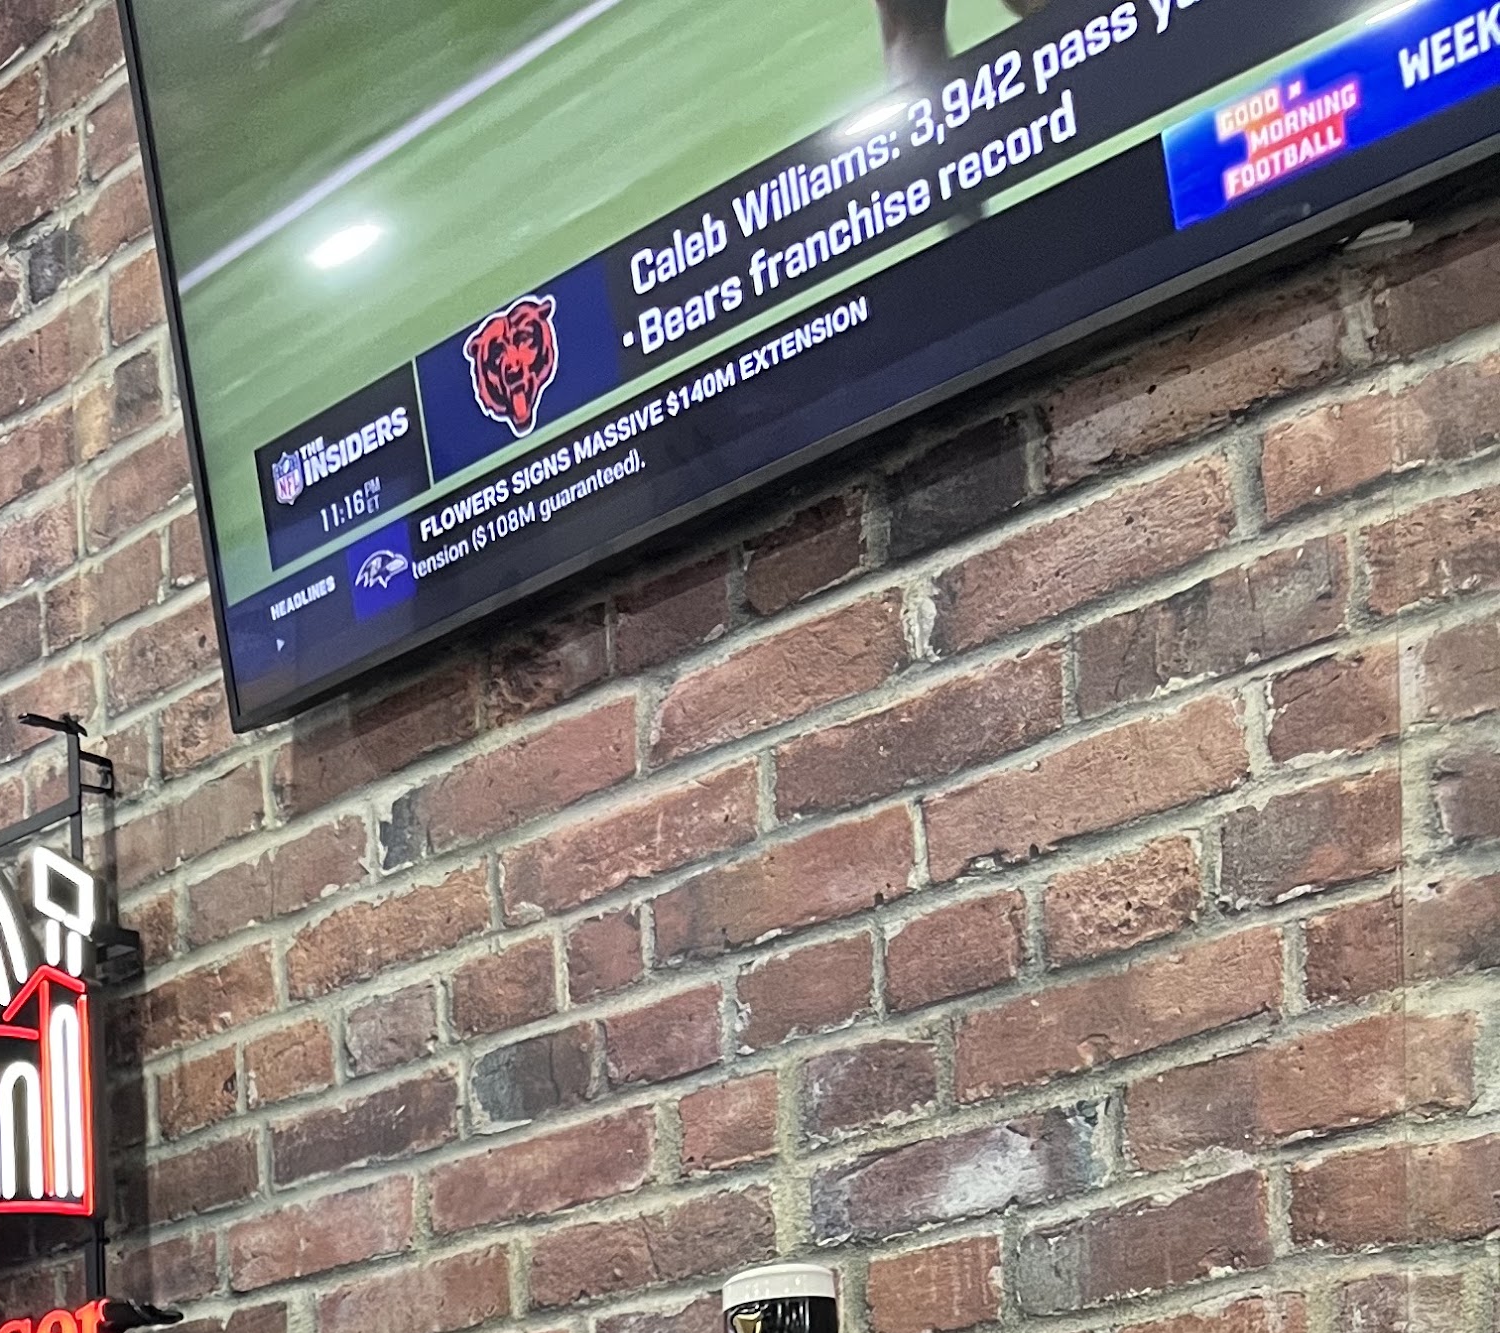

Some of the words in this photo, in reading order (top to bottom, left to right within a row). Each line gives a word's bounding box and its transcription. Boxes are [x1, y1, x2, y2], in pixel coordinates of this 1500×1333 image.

[1398, 2, 1500, 88] WEEK
[1219, 91, 1279, 130] GOOD
[1250, 84, 1357, 152] MORNING
[630, 212, 728, 296] Caleb
[732, 128, 900, 238] Williams:
[906, 50, 1024, 145] 3,942
[1035, 3, 1138, 94] pass
[1226, 126, 1343, 197] FOOTBALL
[637, 274, 744, 356] Bears
[748, 180, 931, 298] franchise
[938, 90, 1078, 202] record
[300, 436, 324, 459] THE
[303, 406, 409, 487] INSIDERS
[419, 480, 510, 542] FLOWERS
[511, 450, 572, 496] SIGNS
[573, 405, 665, 467] MASSIVE
[665, 365, 737, 418] $140M
[738, 295, 869, 382] EXTENSION
[320, 489, 365, 532] 11:16
[471, 501, 537, 554] ($108M
[539, 452, 647, 524] guaranteed).
[270, 575, 336, 621] HEADLINES
